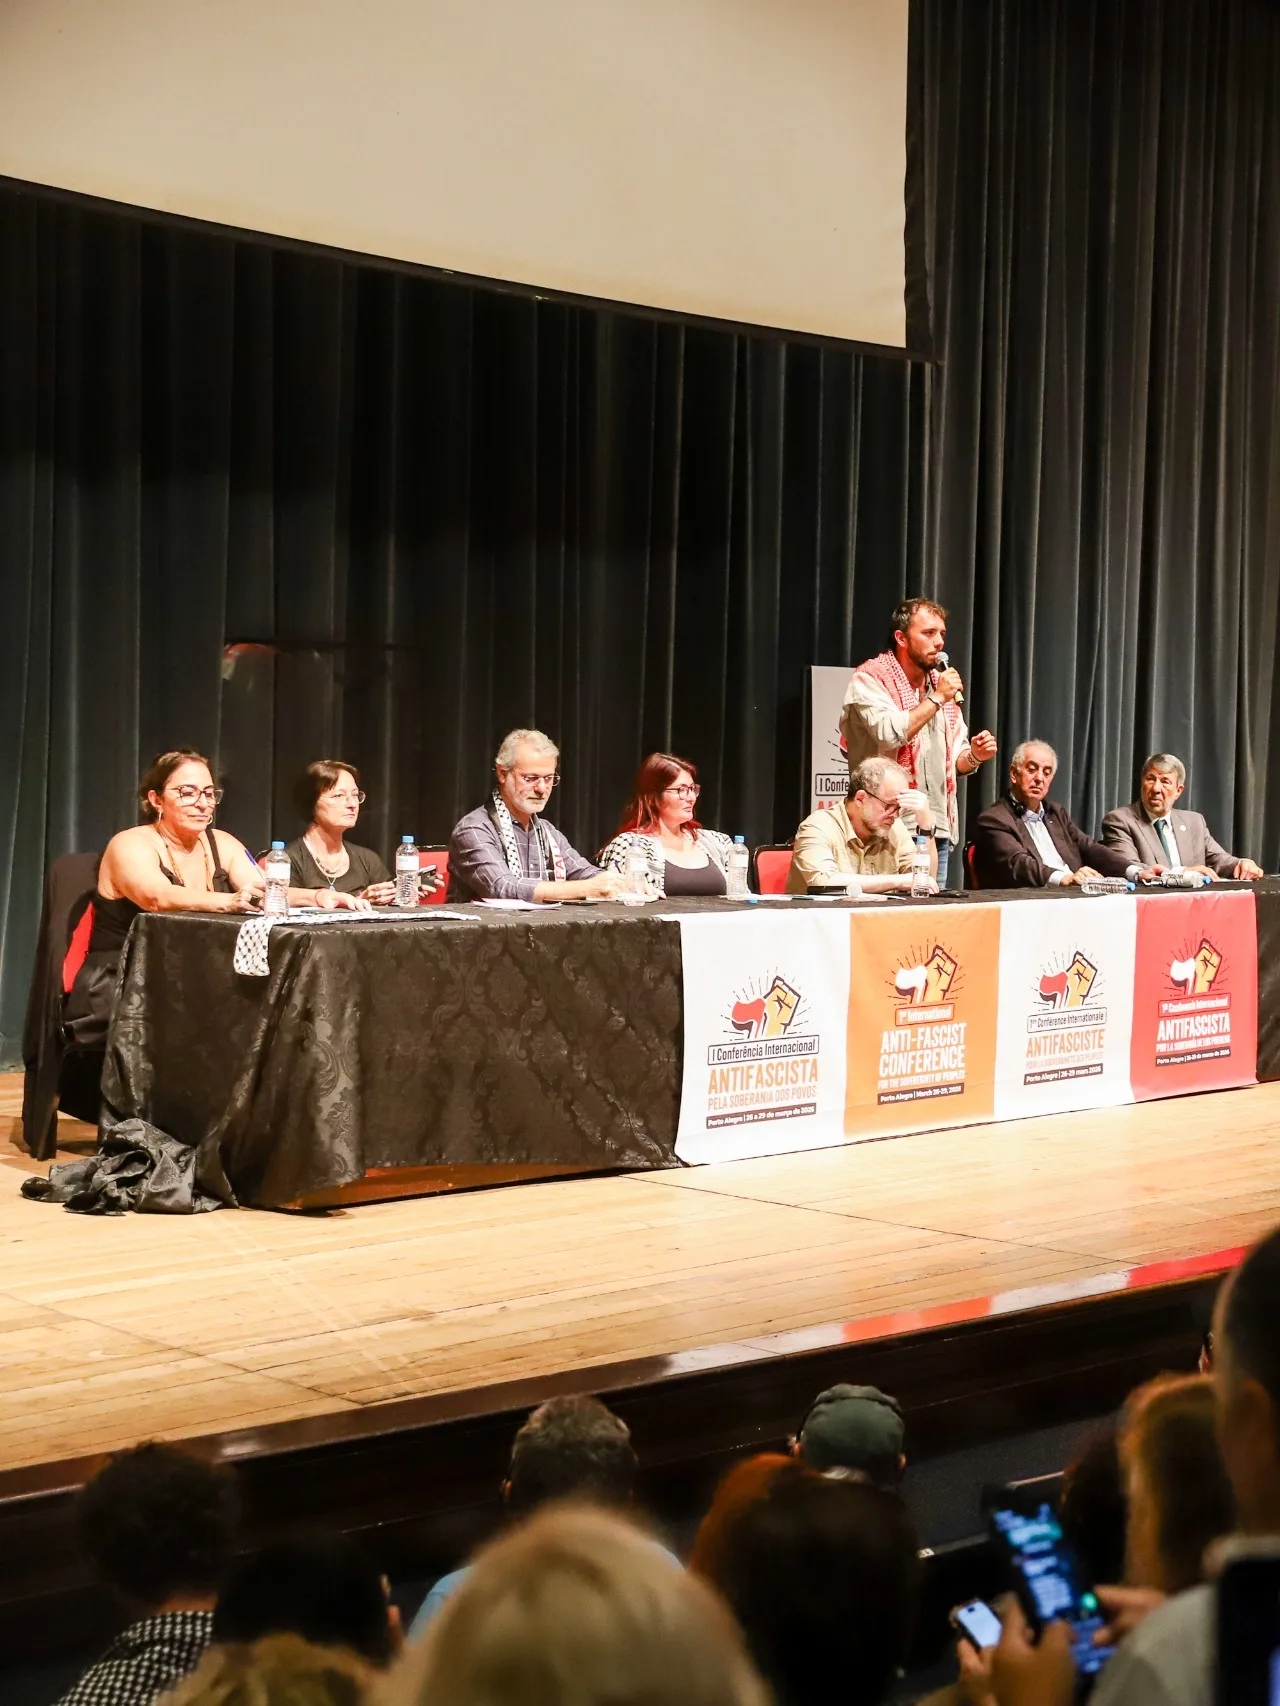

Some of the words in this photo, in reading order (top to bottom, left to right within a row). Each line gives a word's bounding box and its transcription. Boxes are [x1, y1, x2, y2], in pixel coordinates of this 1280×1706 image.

[1067, 1011, 1104, 1024] Internationale
[1157, 1012, 1230, 1042] ANTIFASCISTA
[717, 1044, 763, 1061] Conferência
[765, 1038, 816, 1056] Internacional
[880, 1022, 967, 1054] ANTI-FASCIST
[1026, 1028, 1105, 1058] ANTIFASCISTE
[879, 1044, 966, 1078] CONFERENCE
[708, 1058, 818, 1095] ANTIFASCISTA
[708, 1096, 728, 1111] PELA
[729, 1091, 773, 1109] SOBERANIA
[775, 1088, 790, 1103] DOS
[792, 1085, 817, 1100] POVOS
[880, 1095, 896, 1103] Porto
[895, 1093, 913, 1101] Alegre
[916, 1089, 933, 1097] March
[708, 1119, 724, 1127] Porto
[724, 1116, 743, 1125] Alegre
